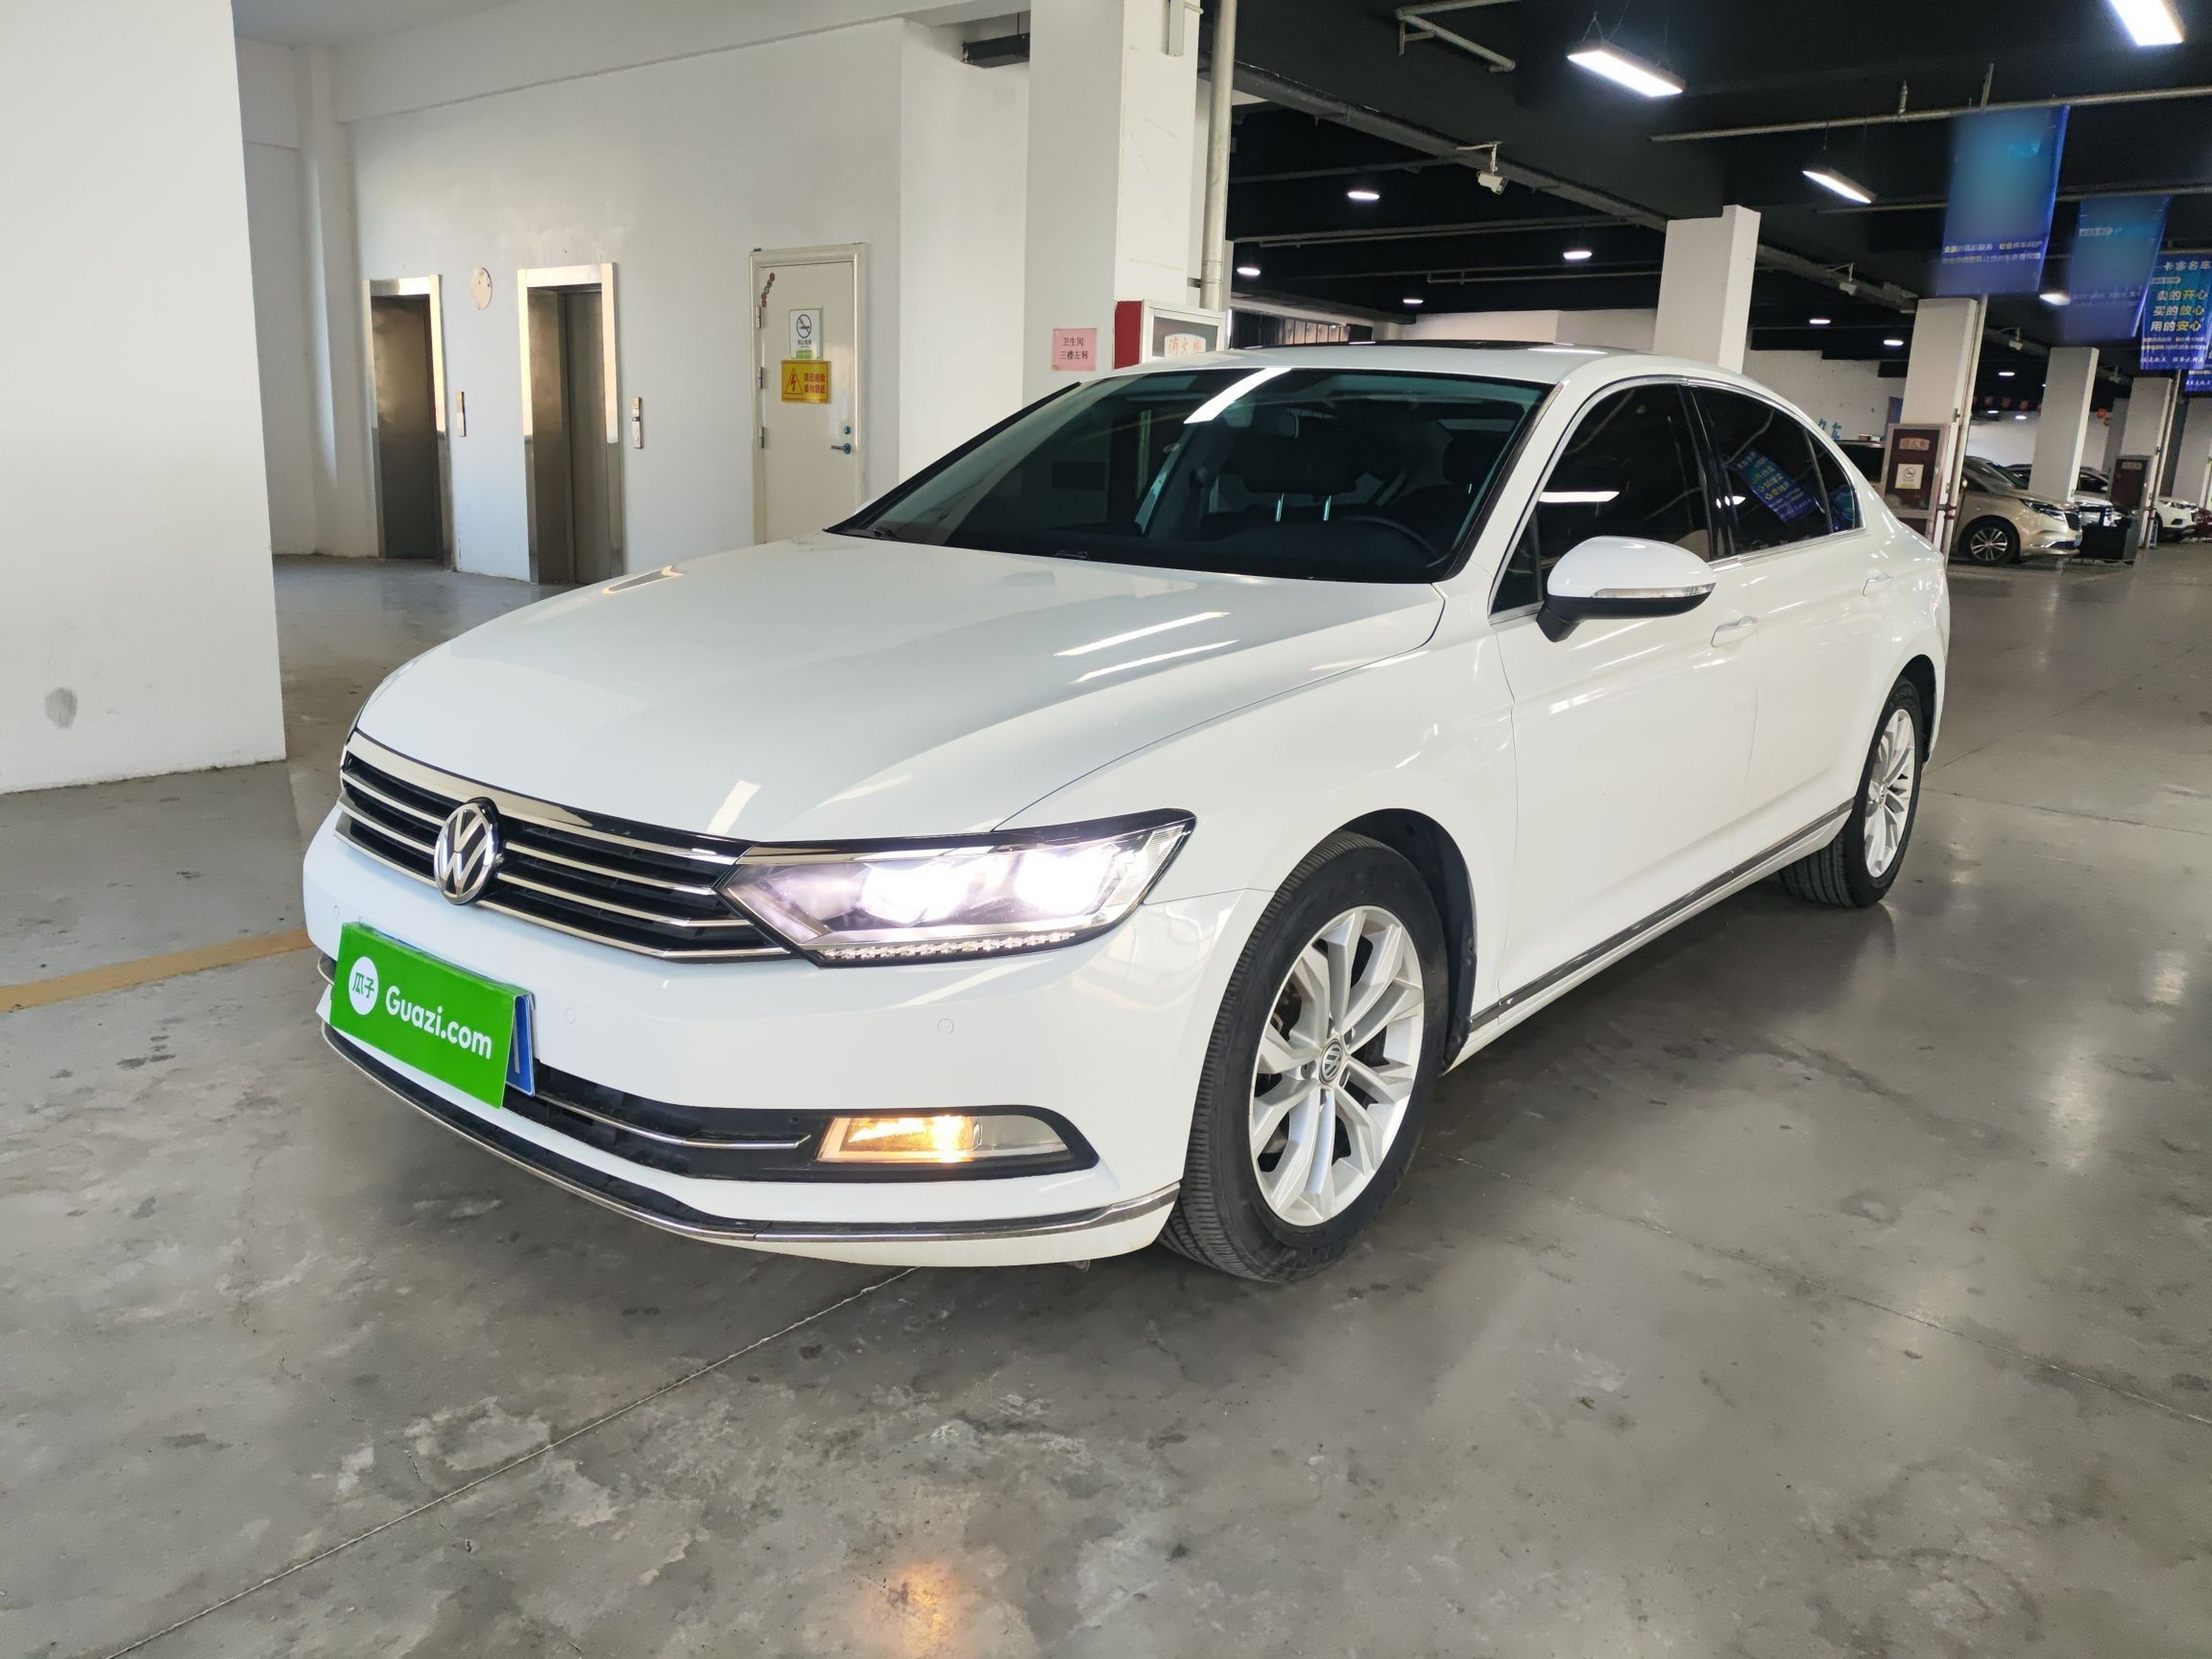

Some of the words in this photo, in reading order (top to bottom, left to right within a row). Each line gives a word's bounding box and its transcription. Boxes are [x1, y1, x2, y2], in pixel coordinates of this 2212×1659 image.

[2156, 290, 2209, 301] 卖的开心
[2153, 305, 2205, 317] 买的放心
[2150, 320, 2202, 332] 用的安心
[1063, 337, 1084, 347] 卫生间
[1059, 350, 1089, 360] 三楼左转
[353, 972, 375, 999] 瓜子
[385, 986, 492, 1060] Guazi.com
